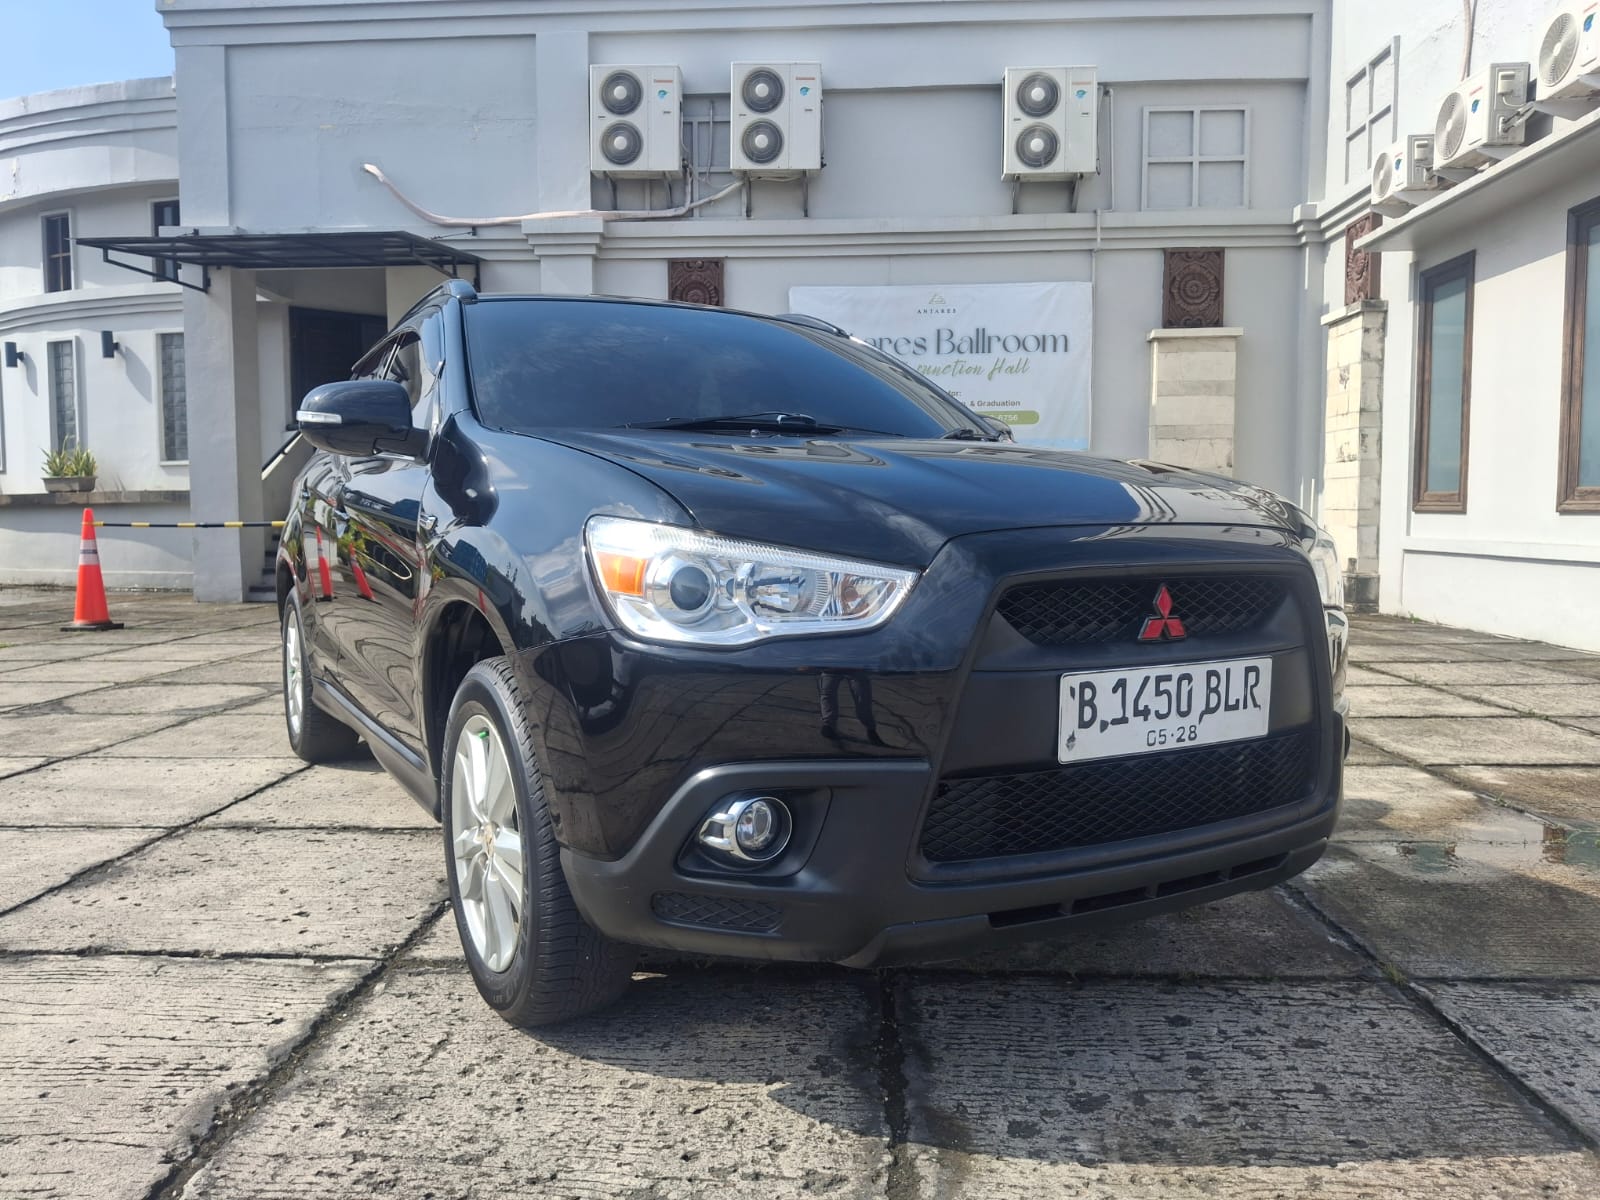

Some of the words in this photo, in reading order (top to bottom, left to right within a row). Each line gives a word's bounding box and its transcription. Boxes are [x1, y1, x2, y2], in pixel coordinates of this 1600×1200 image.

[936, 327, 1069, 355] Ballroom
[916, 359, 985, 378] unction
[987, 356, 1031, 381] Hall
[1077, 680, 1098, 729] B
[1110, 672, 1194, 726] 1450
[1201, 665, 1261, 717] BLR
